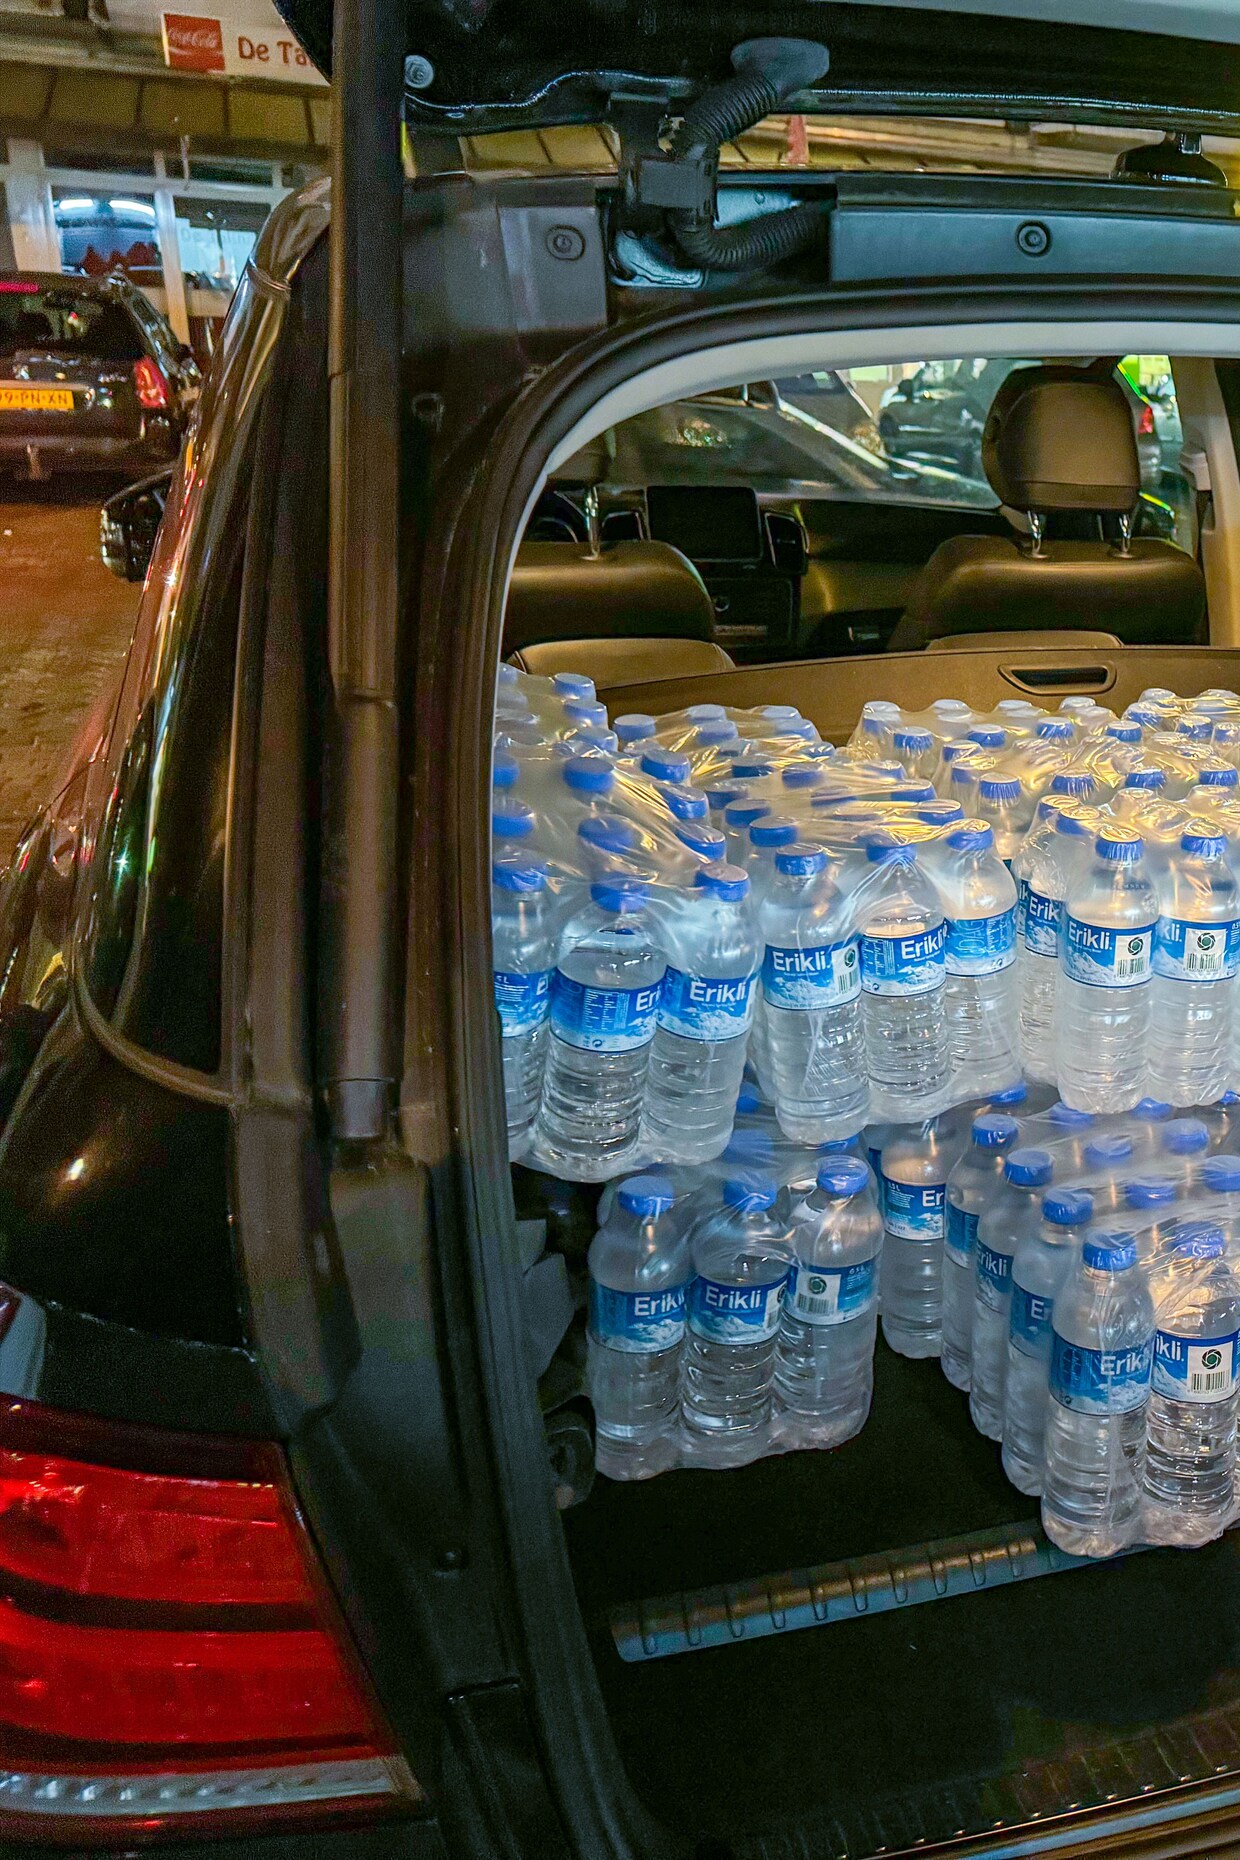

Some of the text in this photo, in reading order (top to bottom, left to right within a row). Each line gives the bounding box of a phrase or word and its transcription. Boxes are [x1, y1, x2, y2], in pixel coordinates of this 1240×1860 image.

[238, 36, 314, 67] De Ta
[0, 390, 68, 405] 9-PN-XN
[1029, 895, 1060, 922] Erik
[1067, 920, 1111, 950] Erikli
[772, 950, 827, 972] Erikli
[689, 980, 747, 1003] Erikli
[705, 1284, 762, 1309] Erikli
[1155, 1333, 1181, 1361] ikli
[1101, 1352, 1143, 1376] Erik
